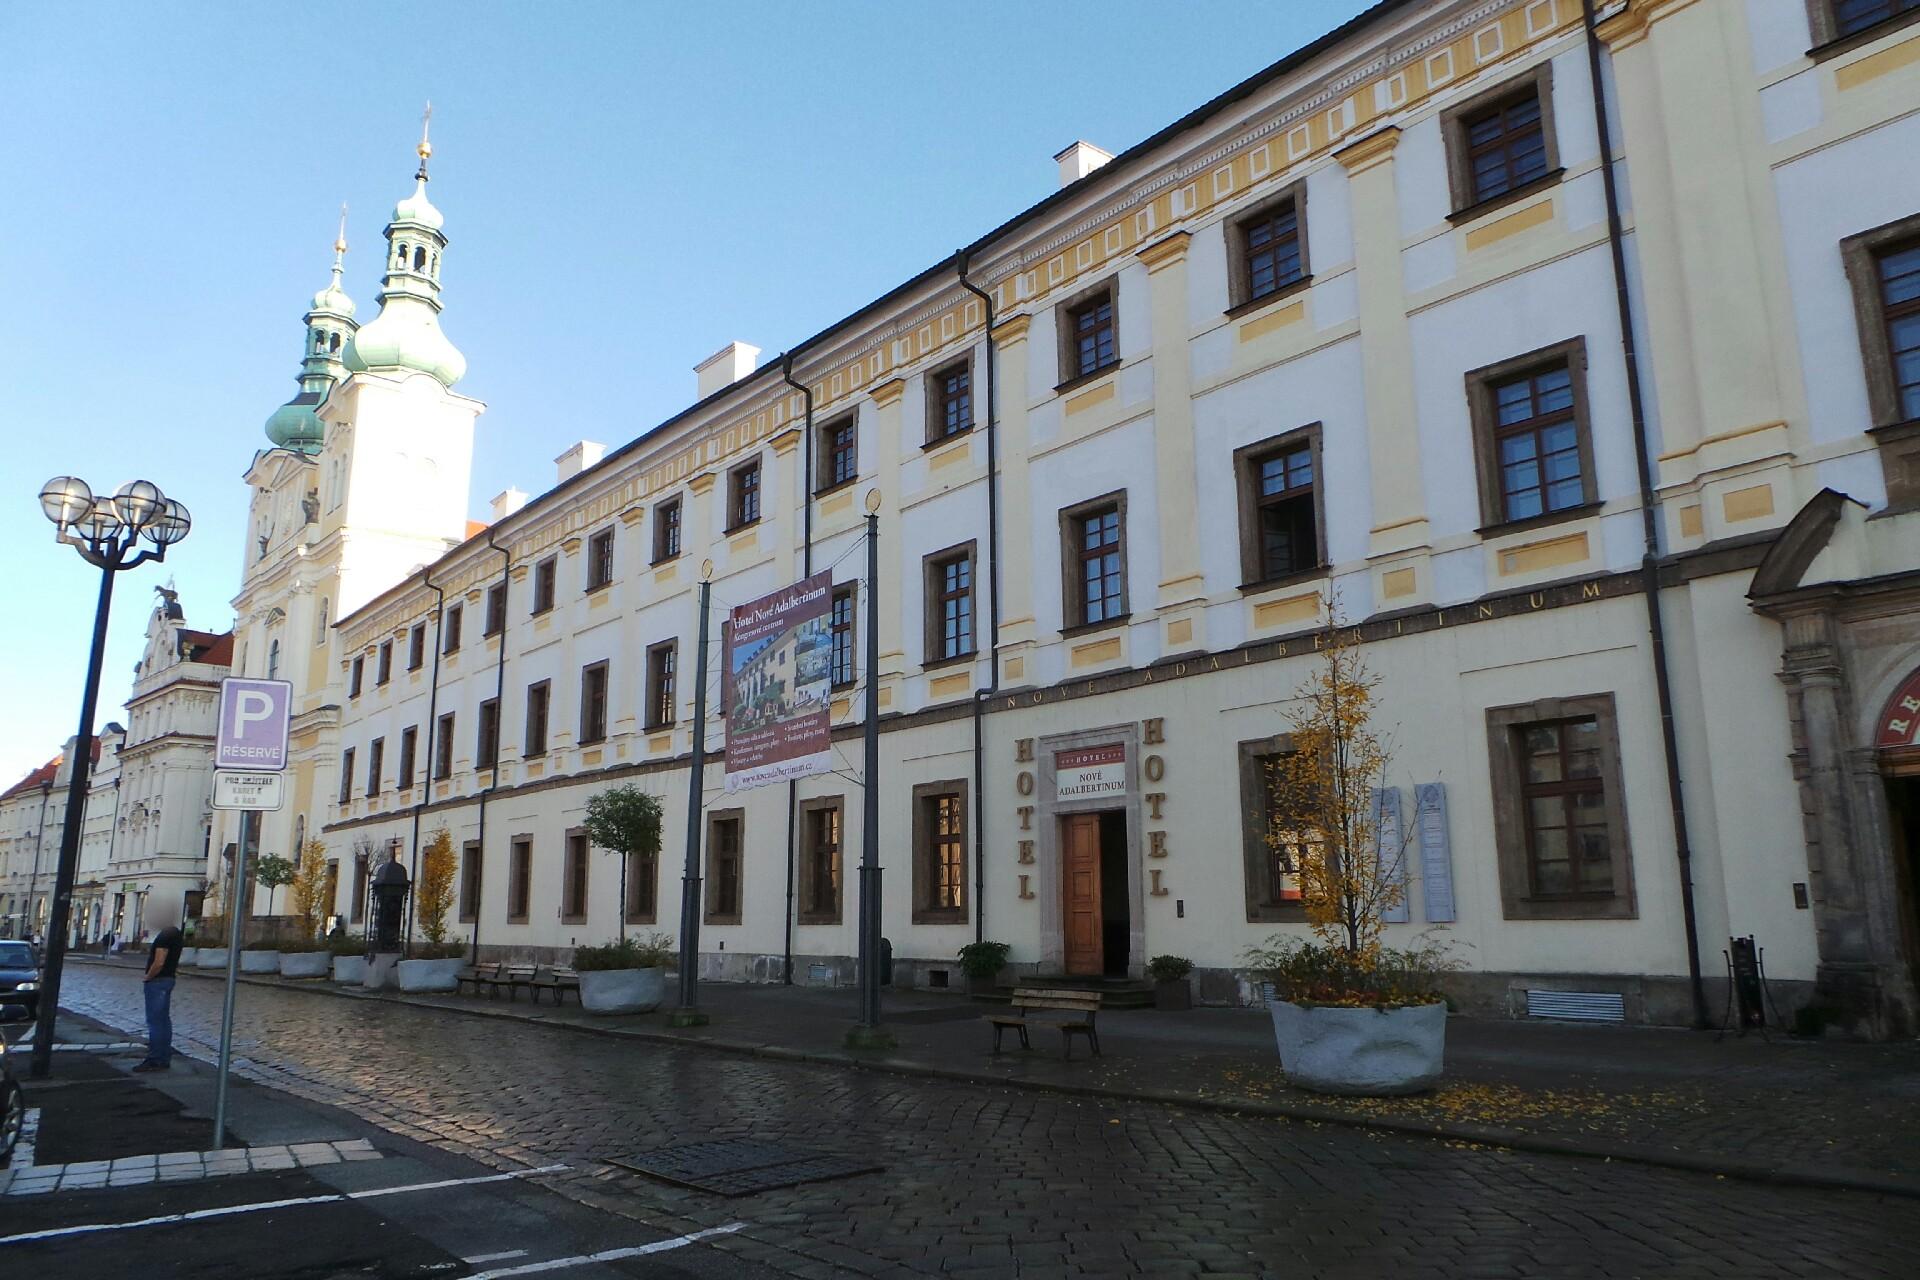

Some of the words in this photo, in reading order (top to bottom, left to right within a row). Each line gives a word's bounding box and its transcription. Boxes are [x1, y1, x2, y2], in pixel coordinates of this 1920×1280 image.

[733, 612, 754, 630] Hotel
[755, 604, 774, 622] Nové
[774, 586, 826, 615] Adalbertinum
[234, 689, 274, 739] P
[223, 744, 281, 759] RÉSERVÉ
[1076, 753, 1106, 764] HOTEL
[1060, 781, 1125, 796] ADALBERTINUM
[1080, 770, 1102, 782] NOVÉ
[1015, 738, 1035, 900] HOTEL
[1142, 717, 1168, 896] HOTEL
